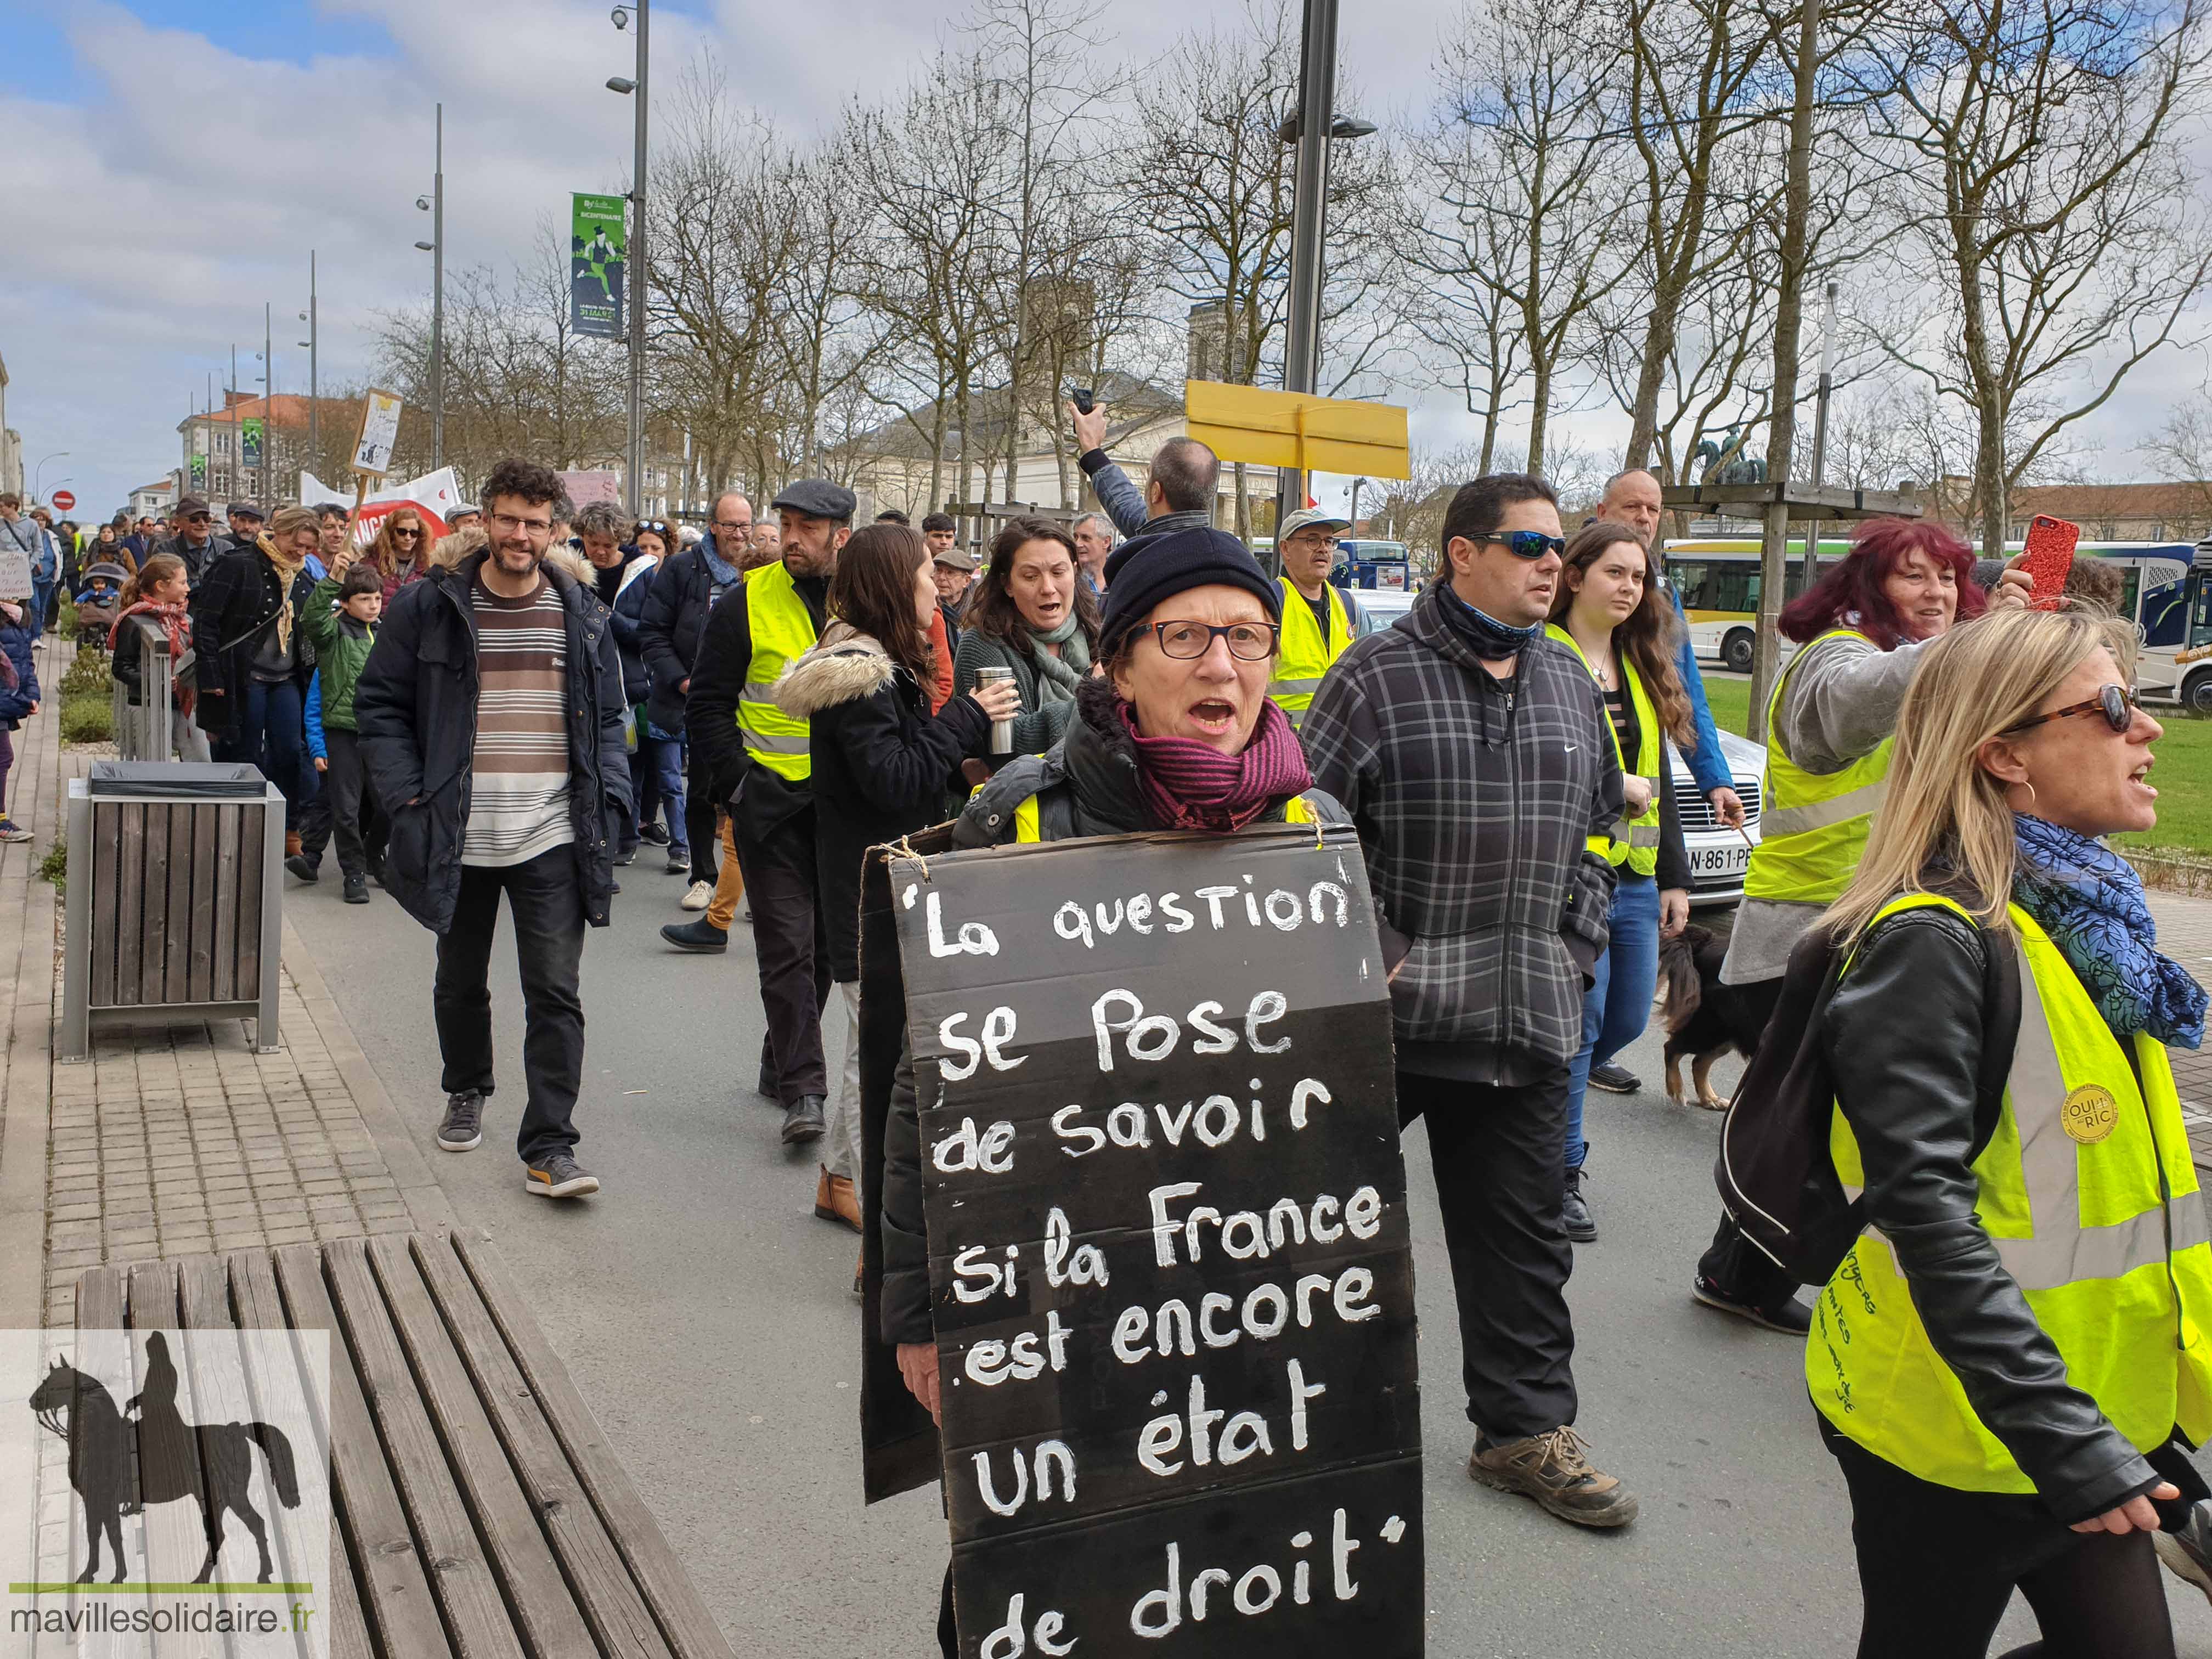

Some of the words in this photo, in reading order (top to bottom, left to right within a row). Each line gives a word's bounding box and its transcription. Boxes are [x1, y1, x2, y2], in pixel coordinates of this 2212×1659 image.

[939, 1006, 1029, 1081] se
[932, 1117, 1015, 1173] de
[1051, 1077, 1331, 1158] savoir
[2069, 1099, 2096, 1117] OUI
[1044, 1206, 1109, 1288] la
[1148, 1182, 1381, 1267] France
[965, 1310, 1074, 1386] est
[1111, 1267, 1380, 1364] encore
[1137, 1358, 1326, 1477] état
[980, 1593, 1078, 1659] de
